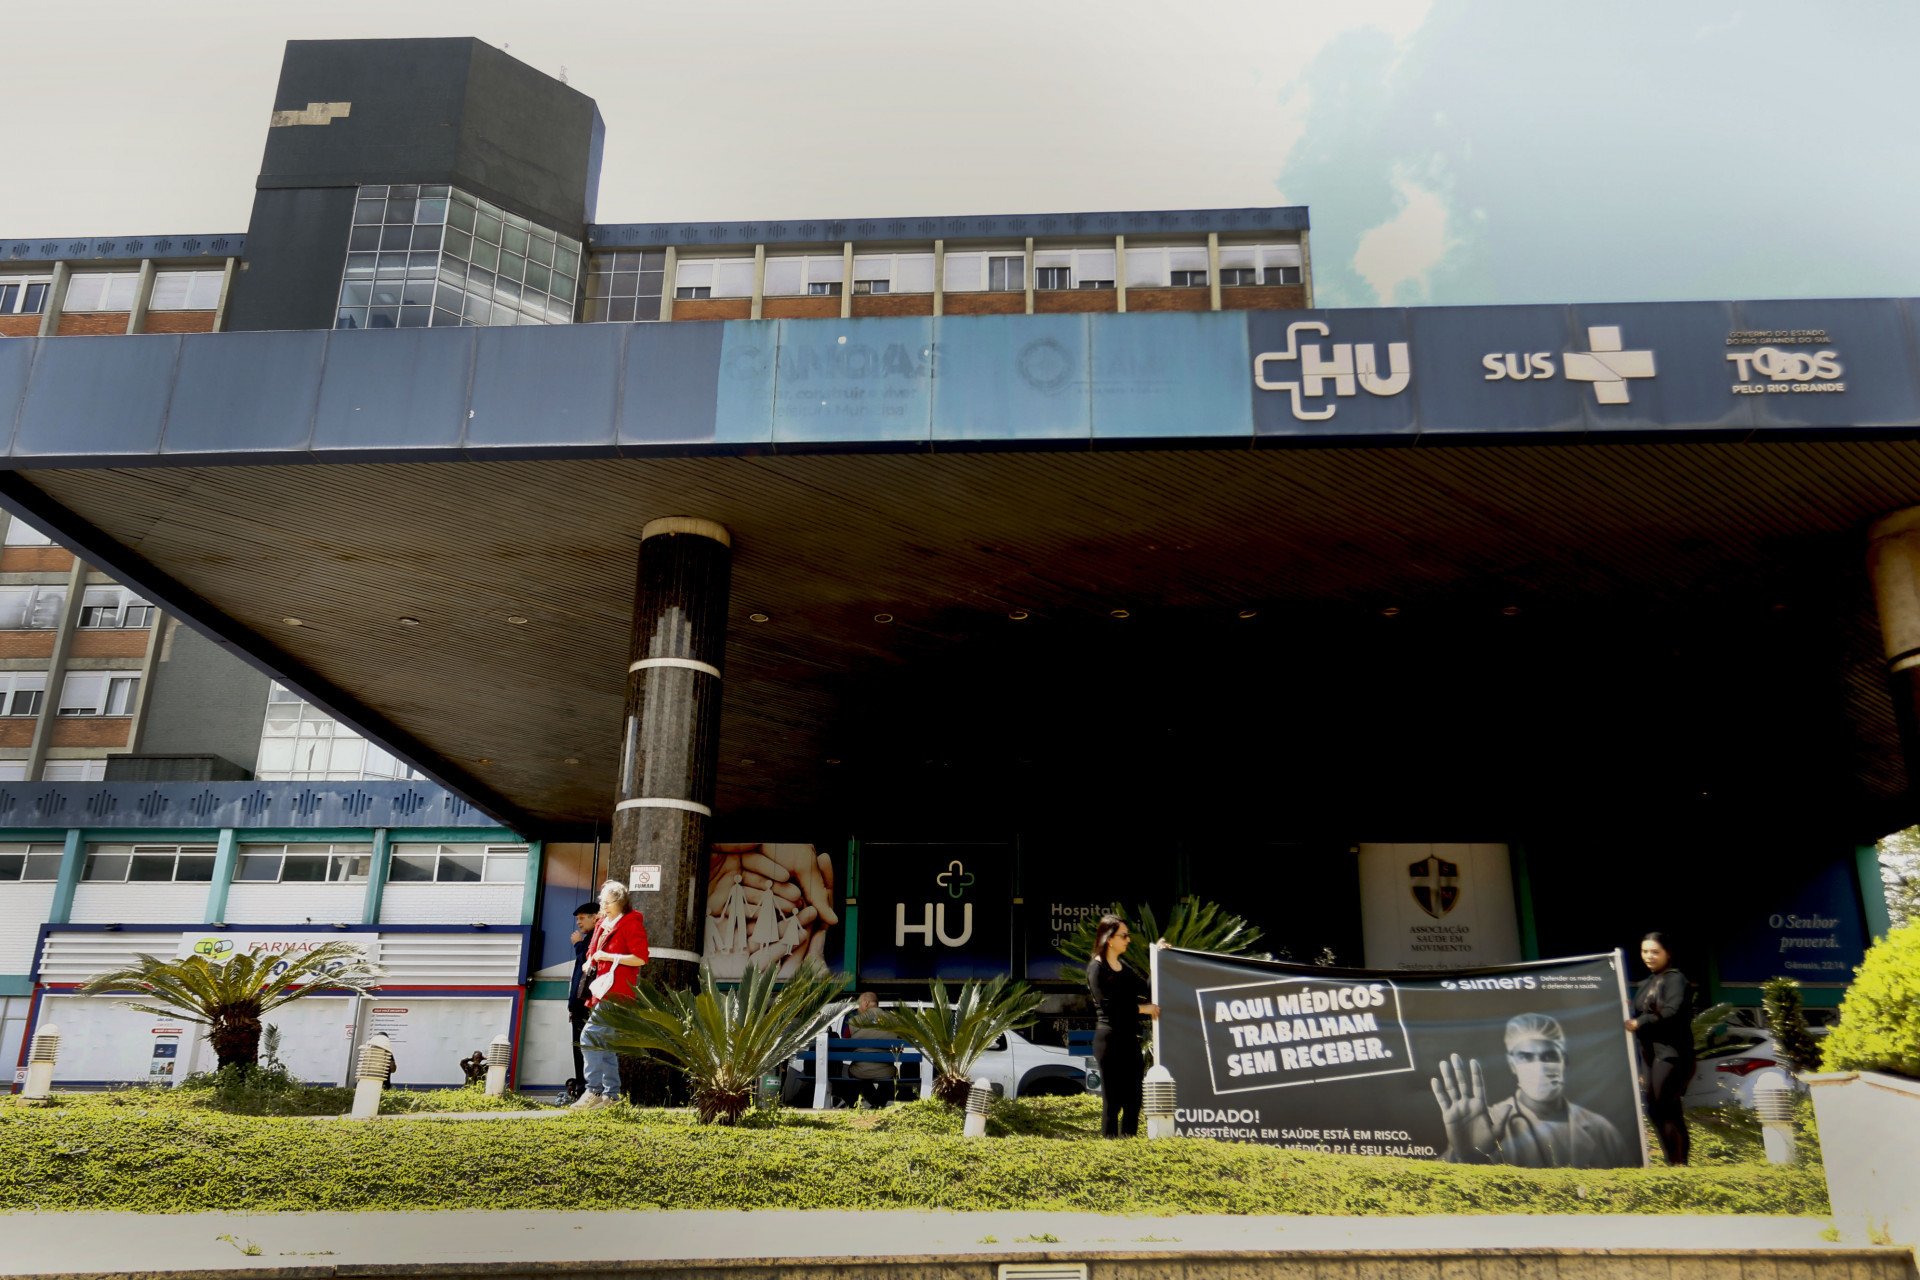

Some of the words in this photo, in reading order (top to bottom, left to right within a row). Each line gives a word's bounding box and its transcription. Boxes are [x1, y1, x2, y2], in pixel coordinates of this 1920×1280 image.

[1729, 330, 1772, 338] GOVERNO
[1301, 343, 1410, 395] HU
[1482, 353, 1555, 380] SUS
[1732, 384, 1765, 394] PELO
[1767, 384, 1790, 393] RIO
[1791, 383, 1845, 393] GRANDE
[1051, 903, 1115, 920] Hospita
[896, 903, 972, 947] HU
[1769, 914, 1783, 928] O
[1786, 914, 1840, 928] Senhor
[1409, 925, 1470, 934] ASSOCIAÇÃO
[1450, 935, 1464, 943] EM
[1779, 934, 1841, 953] proverá.
[1411, 944, 1472, 952] MOVIMENTO
[1459, 975, 1536, 990] simers
[1215, 997, 1274, 1023] AQUI
[1277, 984, 1385, 1016] MÉDICOS
[1229, 1013, 1378, 1048] TRABALHAM
[1227, 1051, 1278, 1077] SEM
[1280, 1037, 1393, 1070] RECEBER.
[1174, 1109, 1261, 1124] CUIDADO!
[1175, 1128, 1184, 1138] A
[1186, 1126, 1258, 1139] ASSISTÊNCIA
[1260, 1128, 1279, 1139] EM
[1281, 1127, 1320, 1140] SAÚDE
[1323, 1127, 1350, 1140] ESTÁ
[1353, 1129, 1371, 1141] EM
[1374, 1130, 1412, 1141] RISCO.
[1350, 1143, 1358, 1155] É
[1360, 1145, 1382, 1156] SEU
[1385, 1143, 1438, 1156] SALÁRIO.
